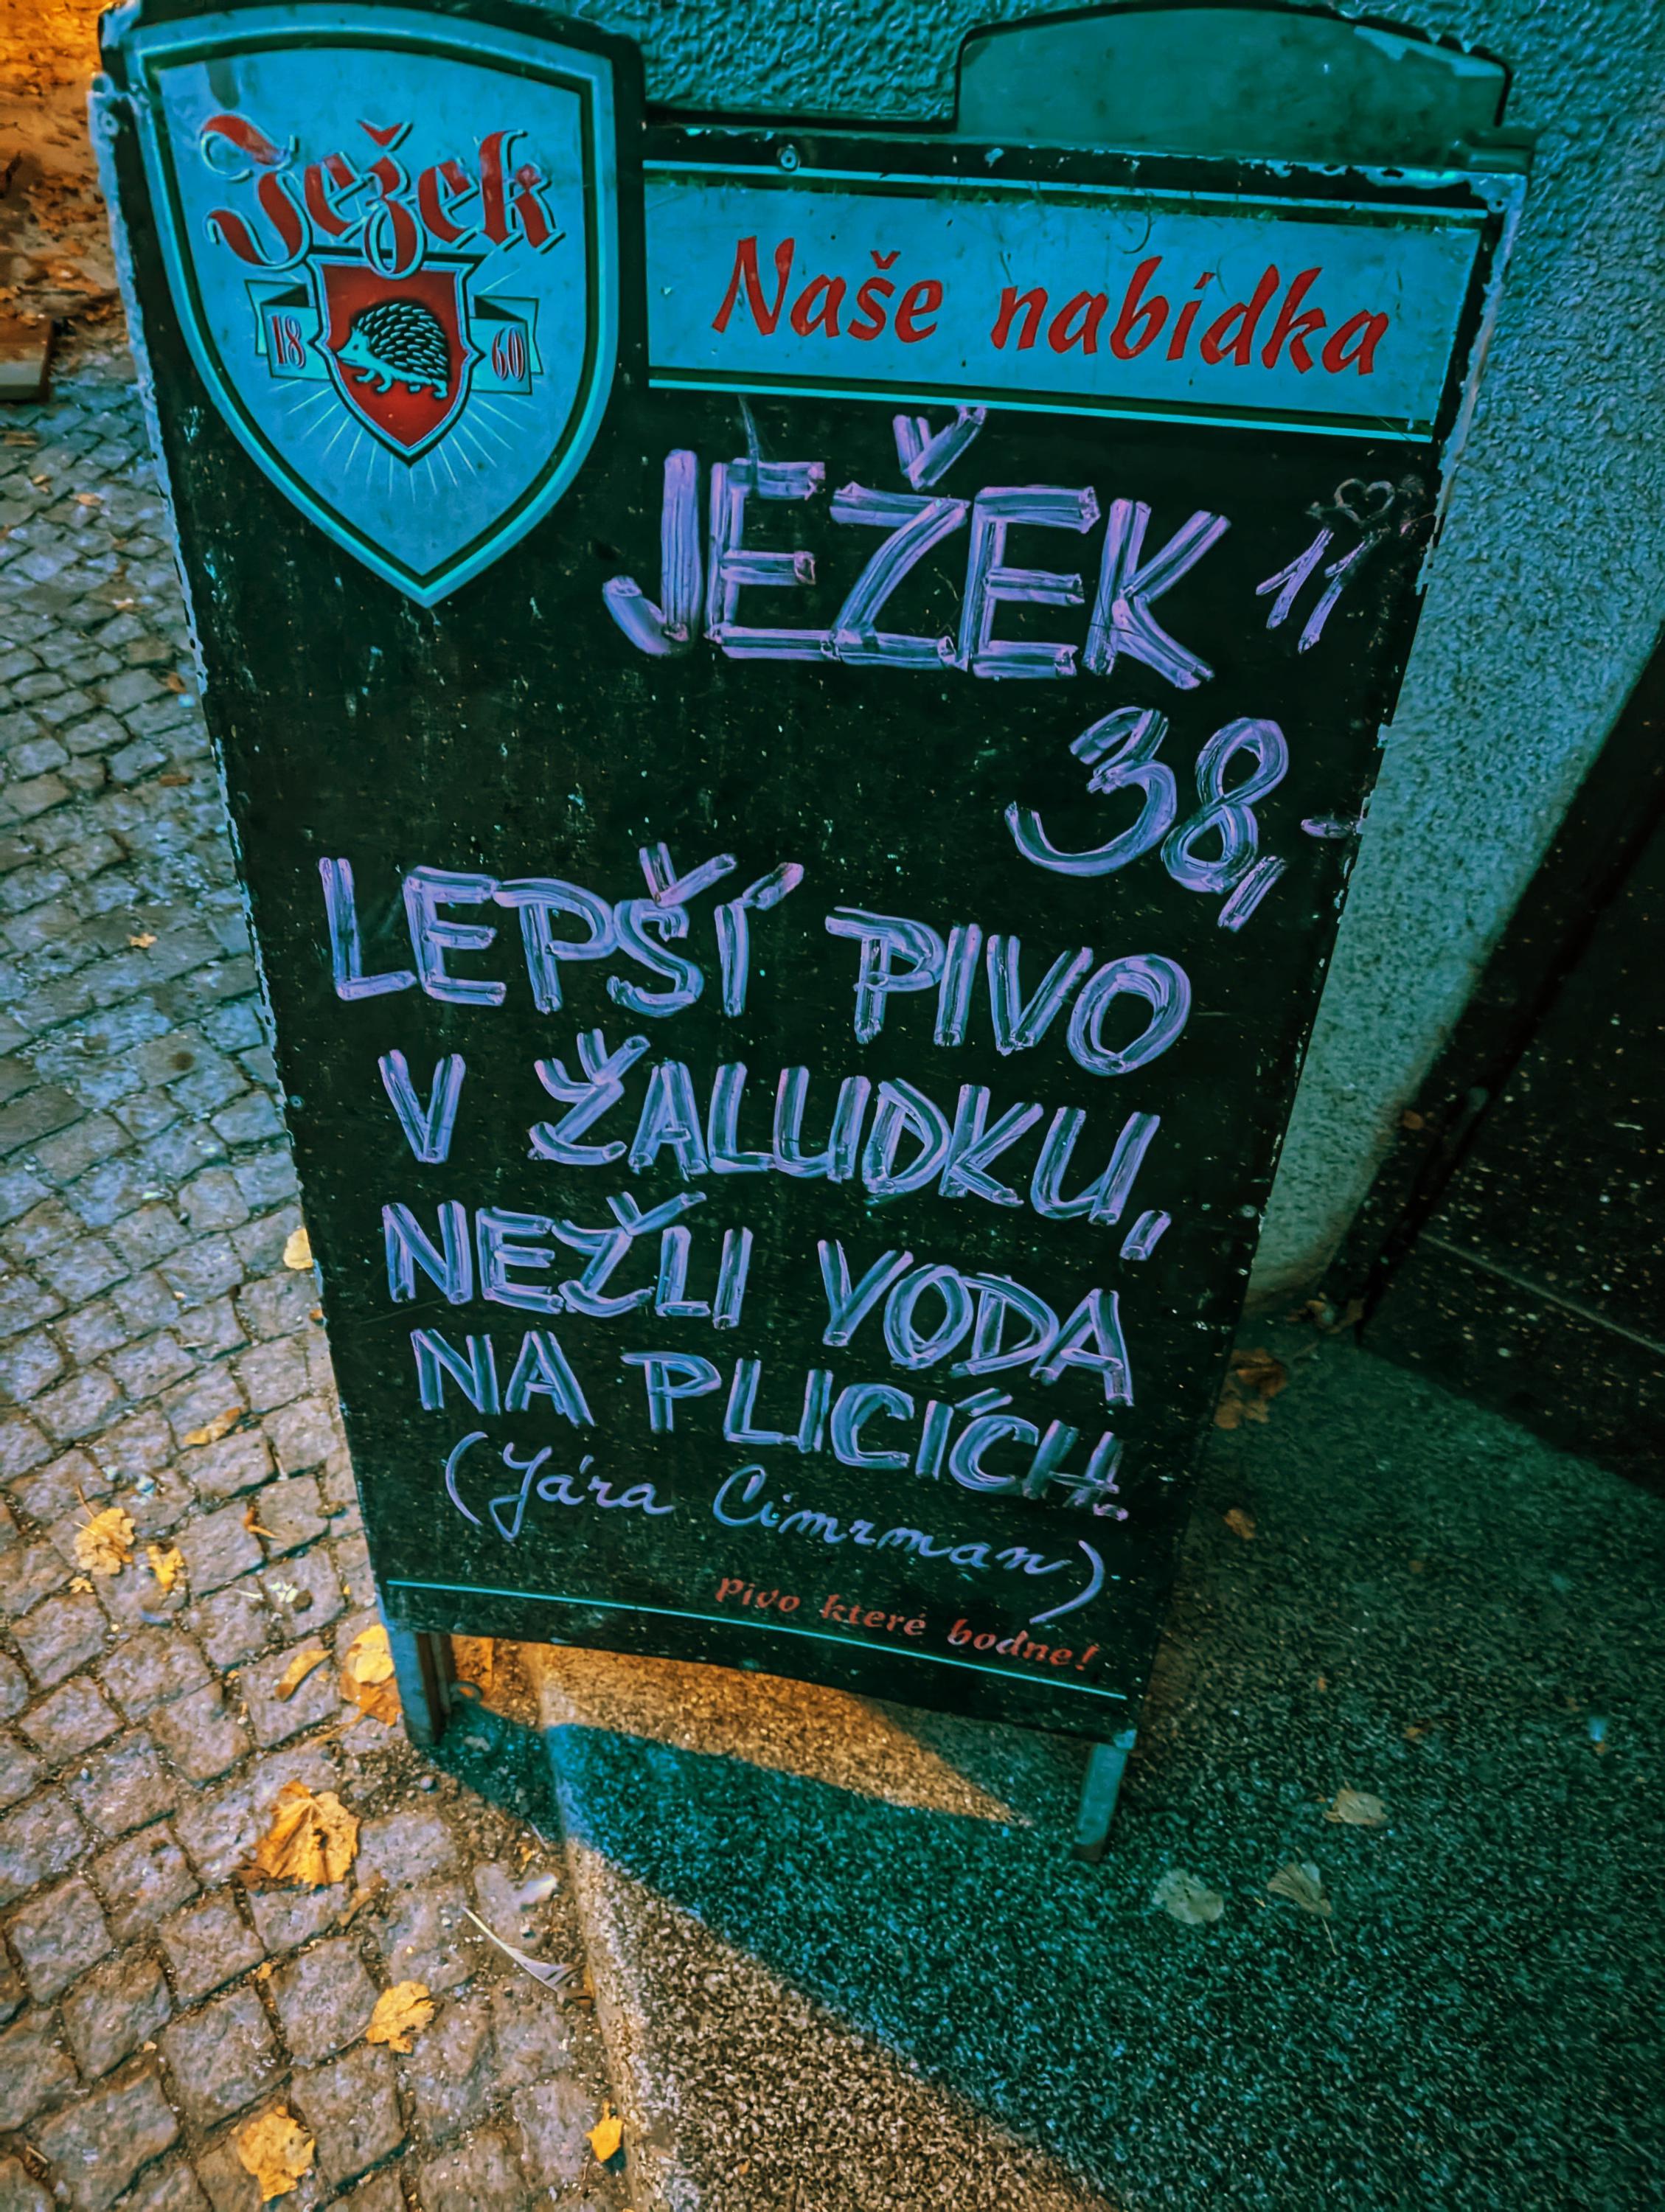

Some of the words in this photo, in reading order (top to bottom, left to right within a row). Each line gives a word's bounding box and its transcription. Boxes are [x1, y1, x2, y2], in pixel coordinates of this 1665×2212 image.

[198, 112, 568, 279] Ježek
[268, 314, 307, 370] 18
[490, 326, 526, 382] 60
[712, 234, 942, 344] Naše
[989, 254, 1392, 375] nabídka
[603, 405, 1232, 690] JEŽEK
[317, 842, 804, 1018] LEPŠÍ
[824, 905, 1192, 1077] PIVO
[378, 1049, 466, 1165] V
[527, 1029, 1171, 1261] ŽALUDKU,
[382, 1190, 754, 1329] NEŽLI
[817, 1237, 1136, 1407] VODA
[410, 1329, 594, 1427] NA
[444, 1432, 675, 1543] (Jára
[712, 1463, 1105, 1625] Cimrman)
[714, 1576, 801, 1613] Pivo
[820, 1593, 928, 1637] které
[946, 1616, 1100, 1672] bodne!
